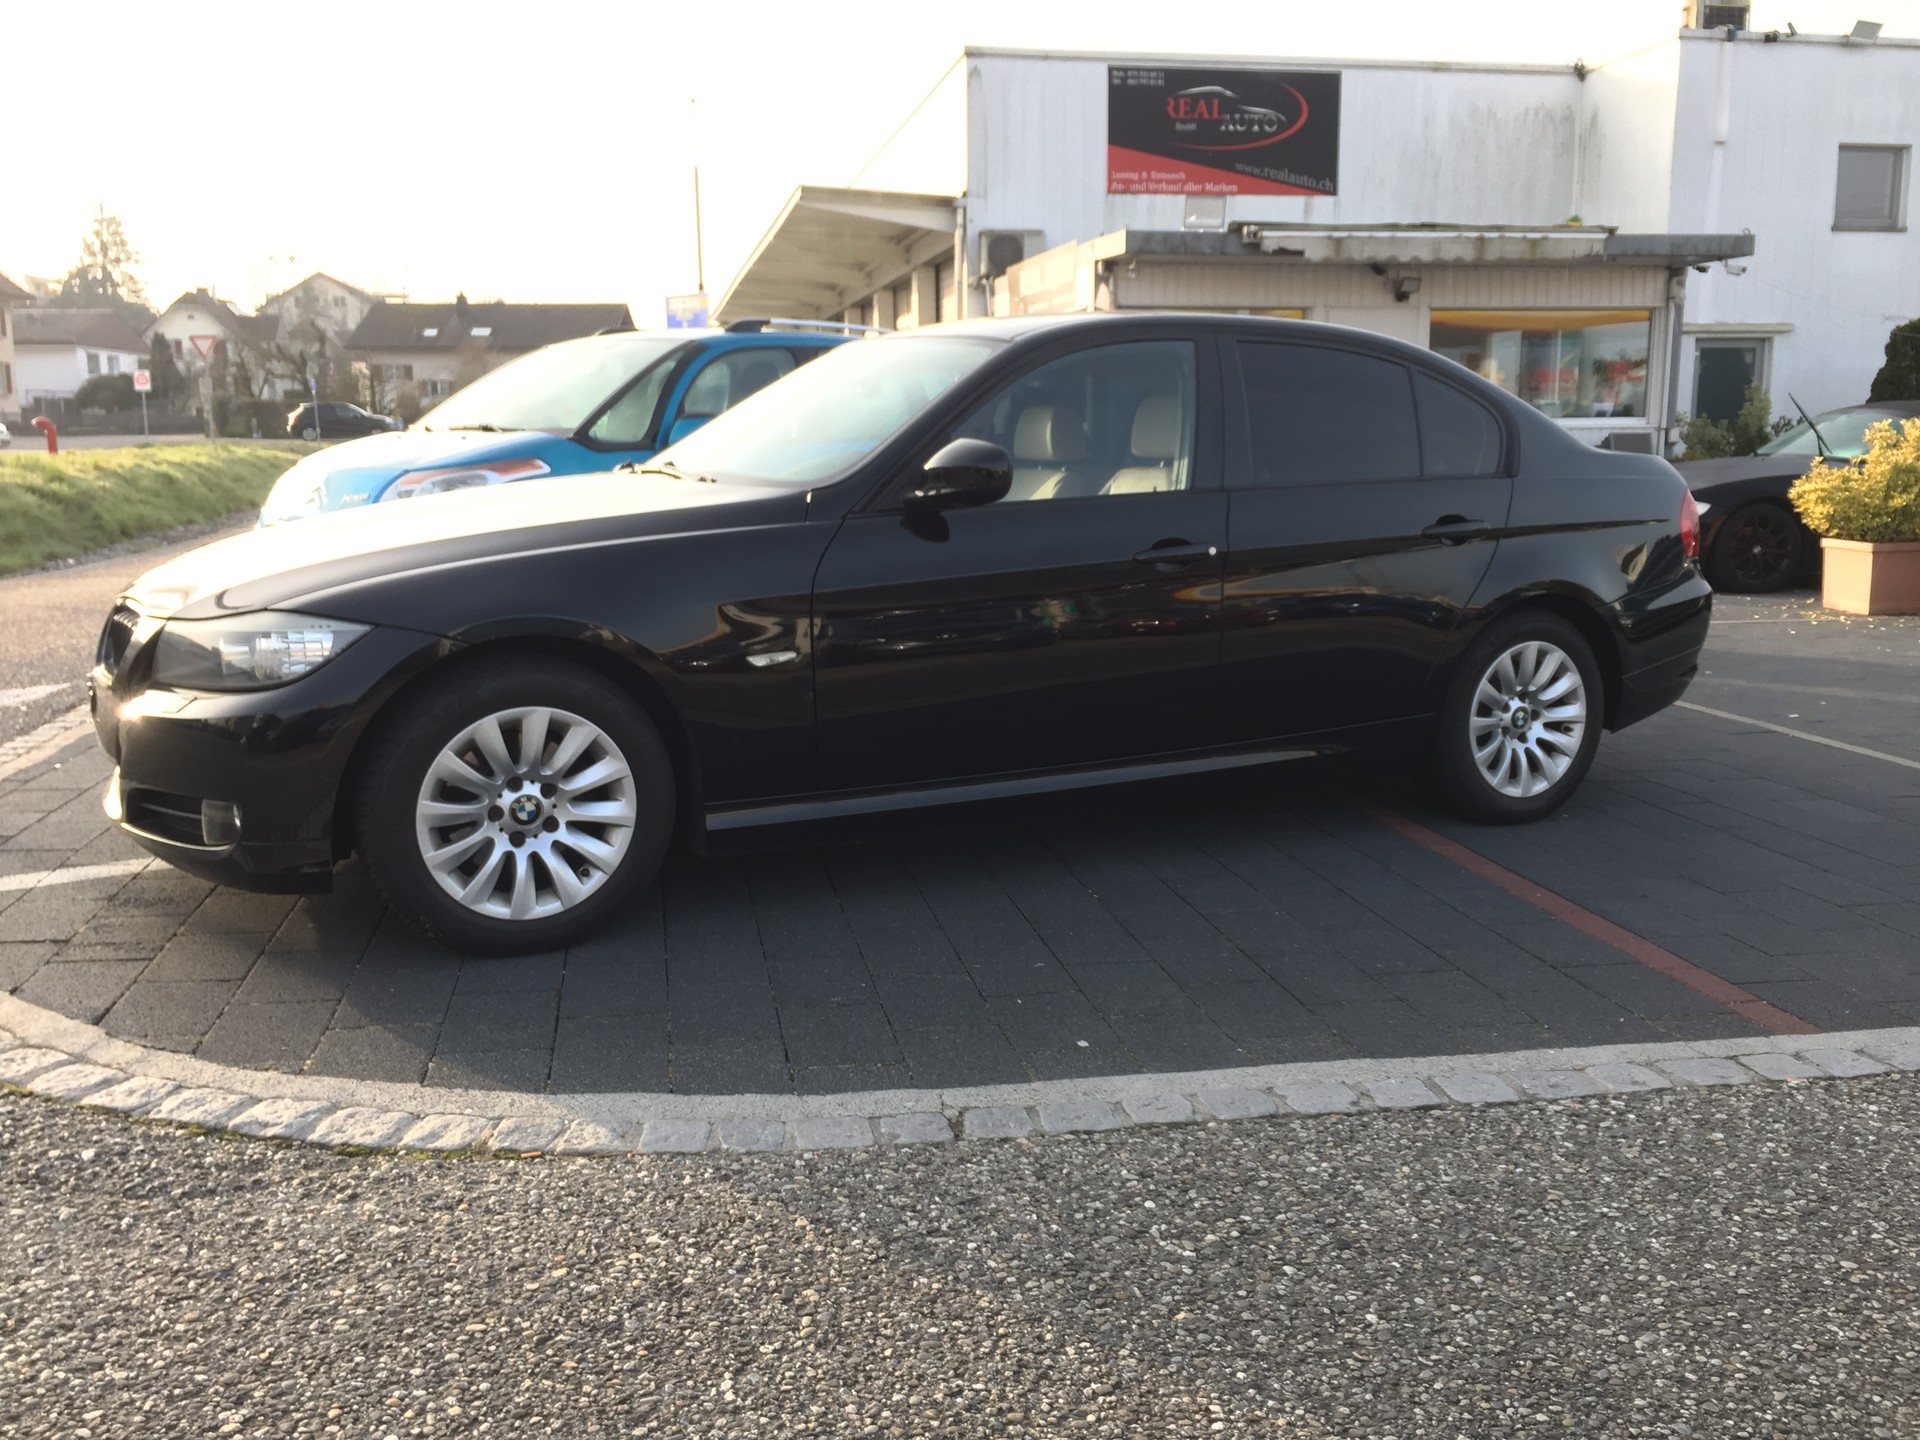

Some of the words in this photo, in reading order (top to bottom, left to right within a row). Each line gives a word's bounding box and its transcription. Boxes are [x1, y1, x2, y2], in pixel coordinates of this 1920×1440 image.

[1167, 97, 1225, 120] REAL
[1219, 112, 1279, 132] AUTO
[1129, 182, 1146, 192] und
[1147, 182, 1182, 192] Verkauf
[1183, 182, 1203, 192] aller
[1205, 182, 1238, 193] Marken
[1234, 162, 1335, 193] www.realauto.ch
